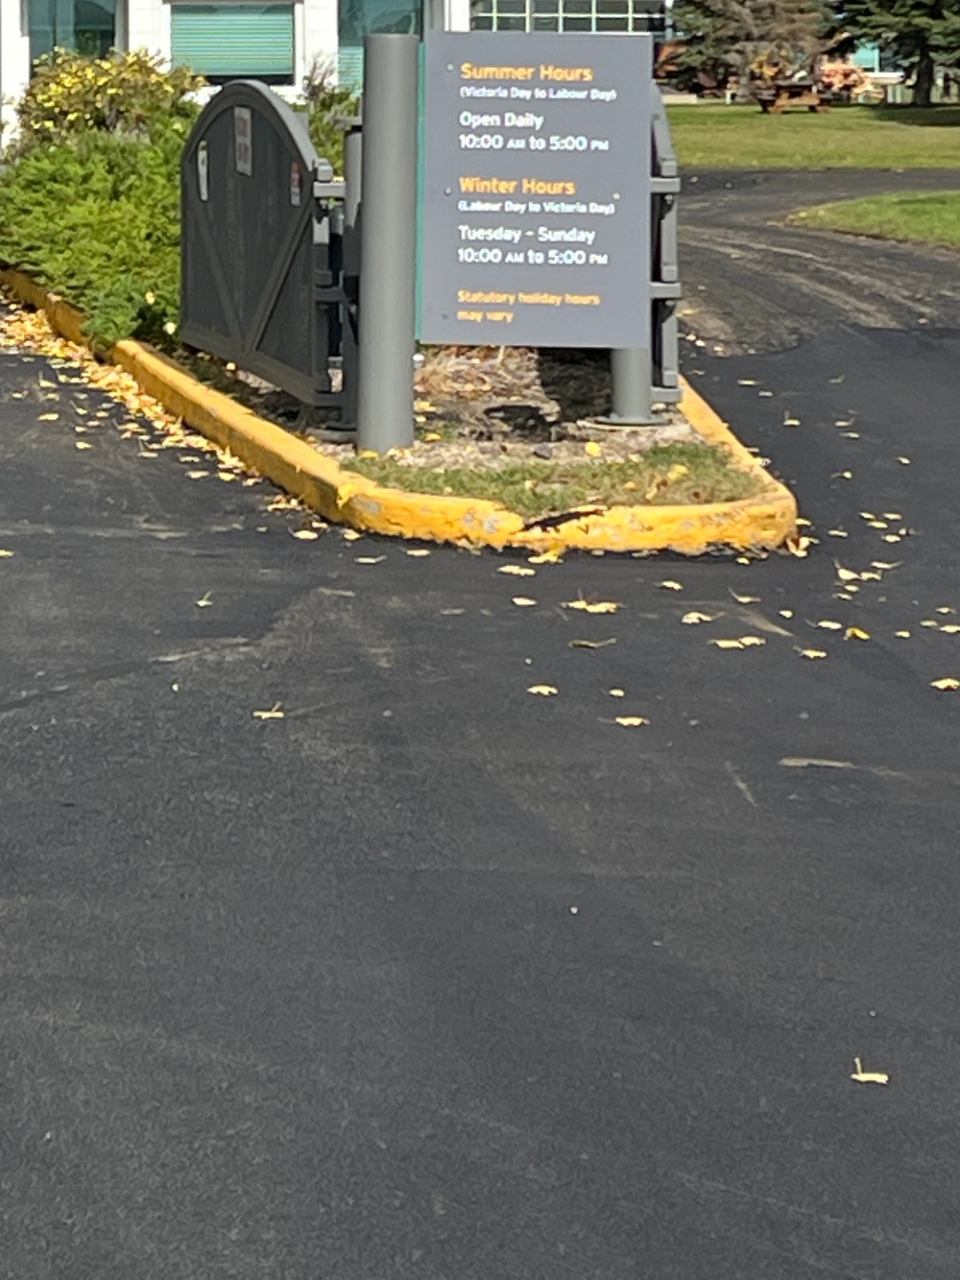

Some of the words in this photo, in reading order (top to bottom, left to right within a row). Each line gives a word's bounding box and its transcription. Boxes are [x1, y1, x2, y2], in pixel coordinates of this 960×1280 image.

[460, 63, 535, 80] Summer
[540, 65, 593, 81] Hours
[460, 87, 508, 99] (Victoria
[510, 87, 532, 100] Day
[534, 88, 547, 99] to
[548, 88, 588, 99] Labour
[590, 89, 617, 102] Day)
[459, 111, 501, 128] Open
[504, 112, 544, 130] Daily
[459, 134, 504, 149] 10:00
[506, 139, 526, 149] AM
[529, 135, 546, 150] to
[549, 136, 587, 150] 5:00
[591, 140, 609, 151] PM
[459, 176, 517, 194] Winter
[522, 178, 576, 195] Hours
[458, 200, 502, 212] (Labour
[504, 201, 526, 214] Day
[528, 201, 541, 212] to
[543, 202, 587, 213] Victoria
[589, 203, 616, 216] Day)
[458, 224, 522, 243] Tuesday
[538, 226, 595, 245] Sunday
[458, 248, 502, 263] 10:00
[505, 252, 524, 263] AM
[527, 249, 544, 264] to
[548, 250, 586, 264] 5:00
[589, 254, 608, 265] PM
